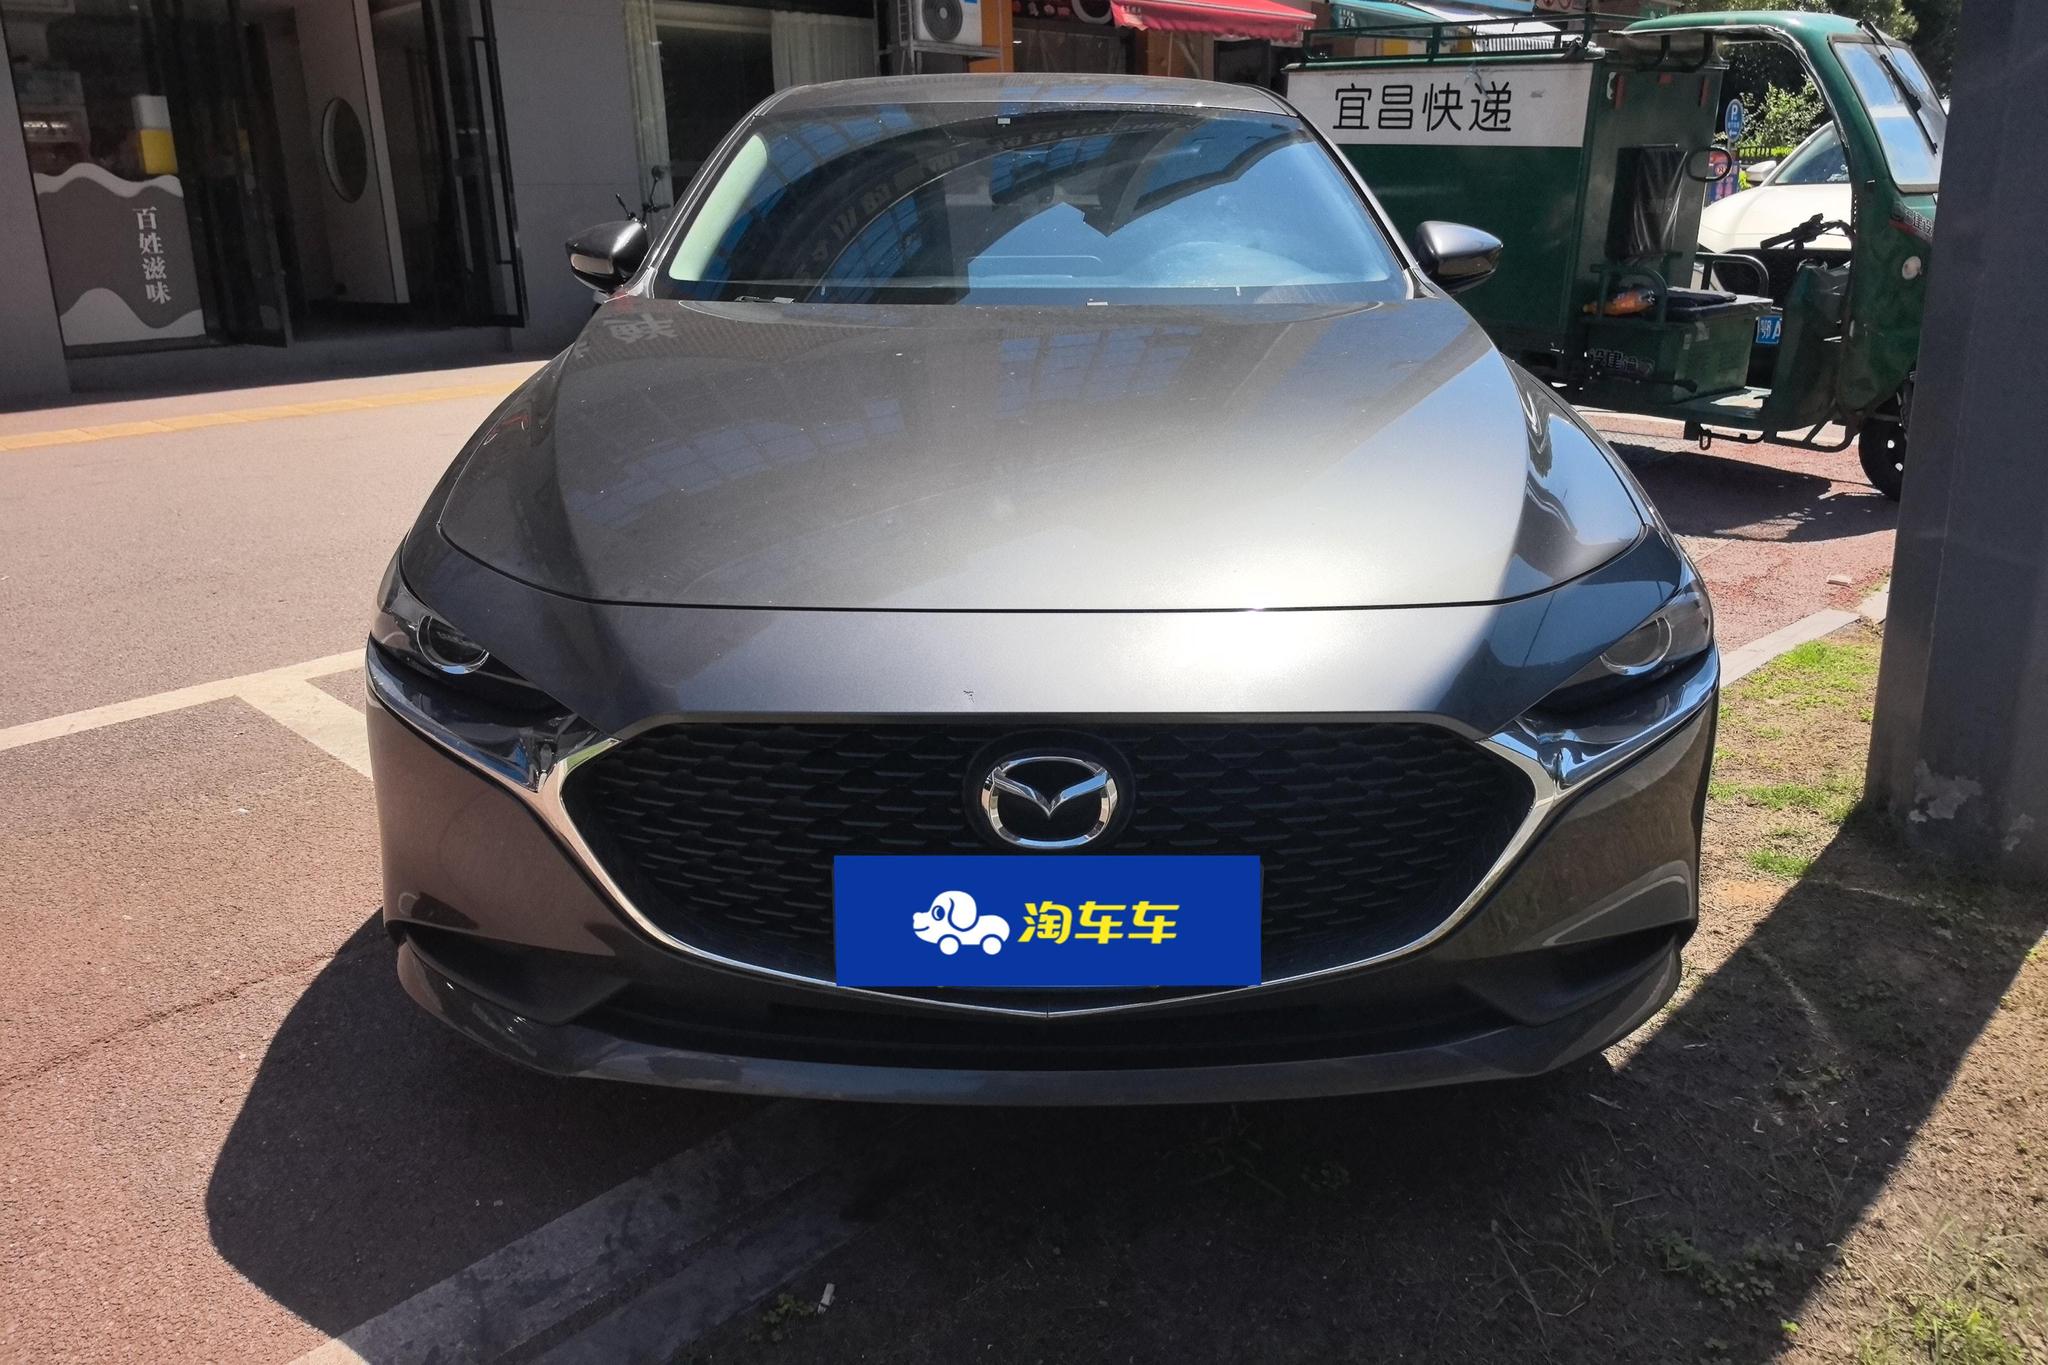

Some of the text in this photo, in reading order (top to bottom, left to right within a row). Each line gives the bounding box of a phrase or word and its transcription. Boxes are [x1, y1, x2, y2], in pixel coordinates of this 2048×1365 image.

[1333, 81, 1512, 132] 宜昌快递
[1731, 104, 1738, 121] P
[132, 206, 172, 305] 百姓滋味
